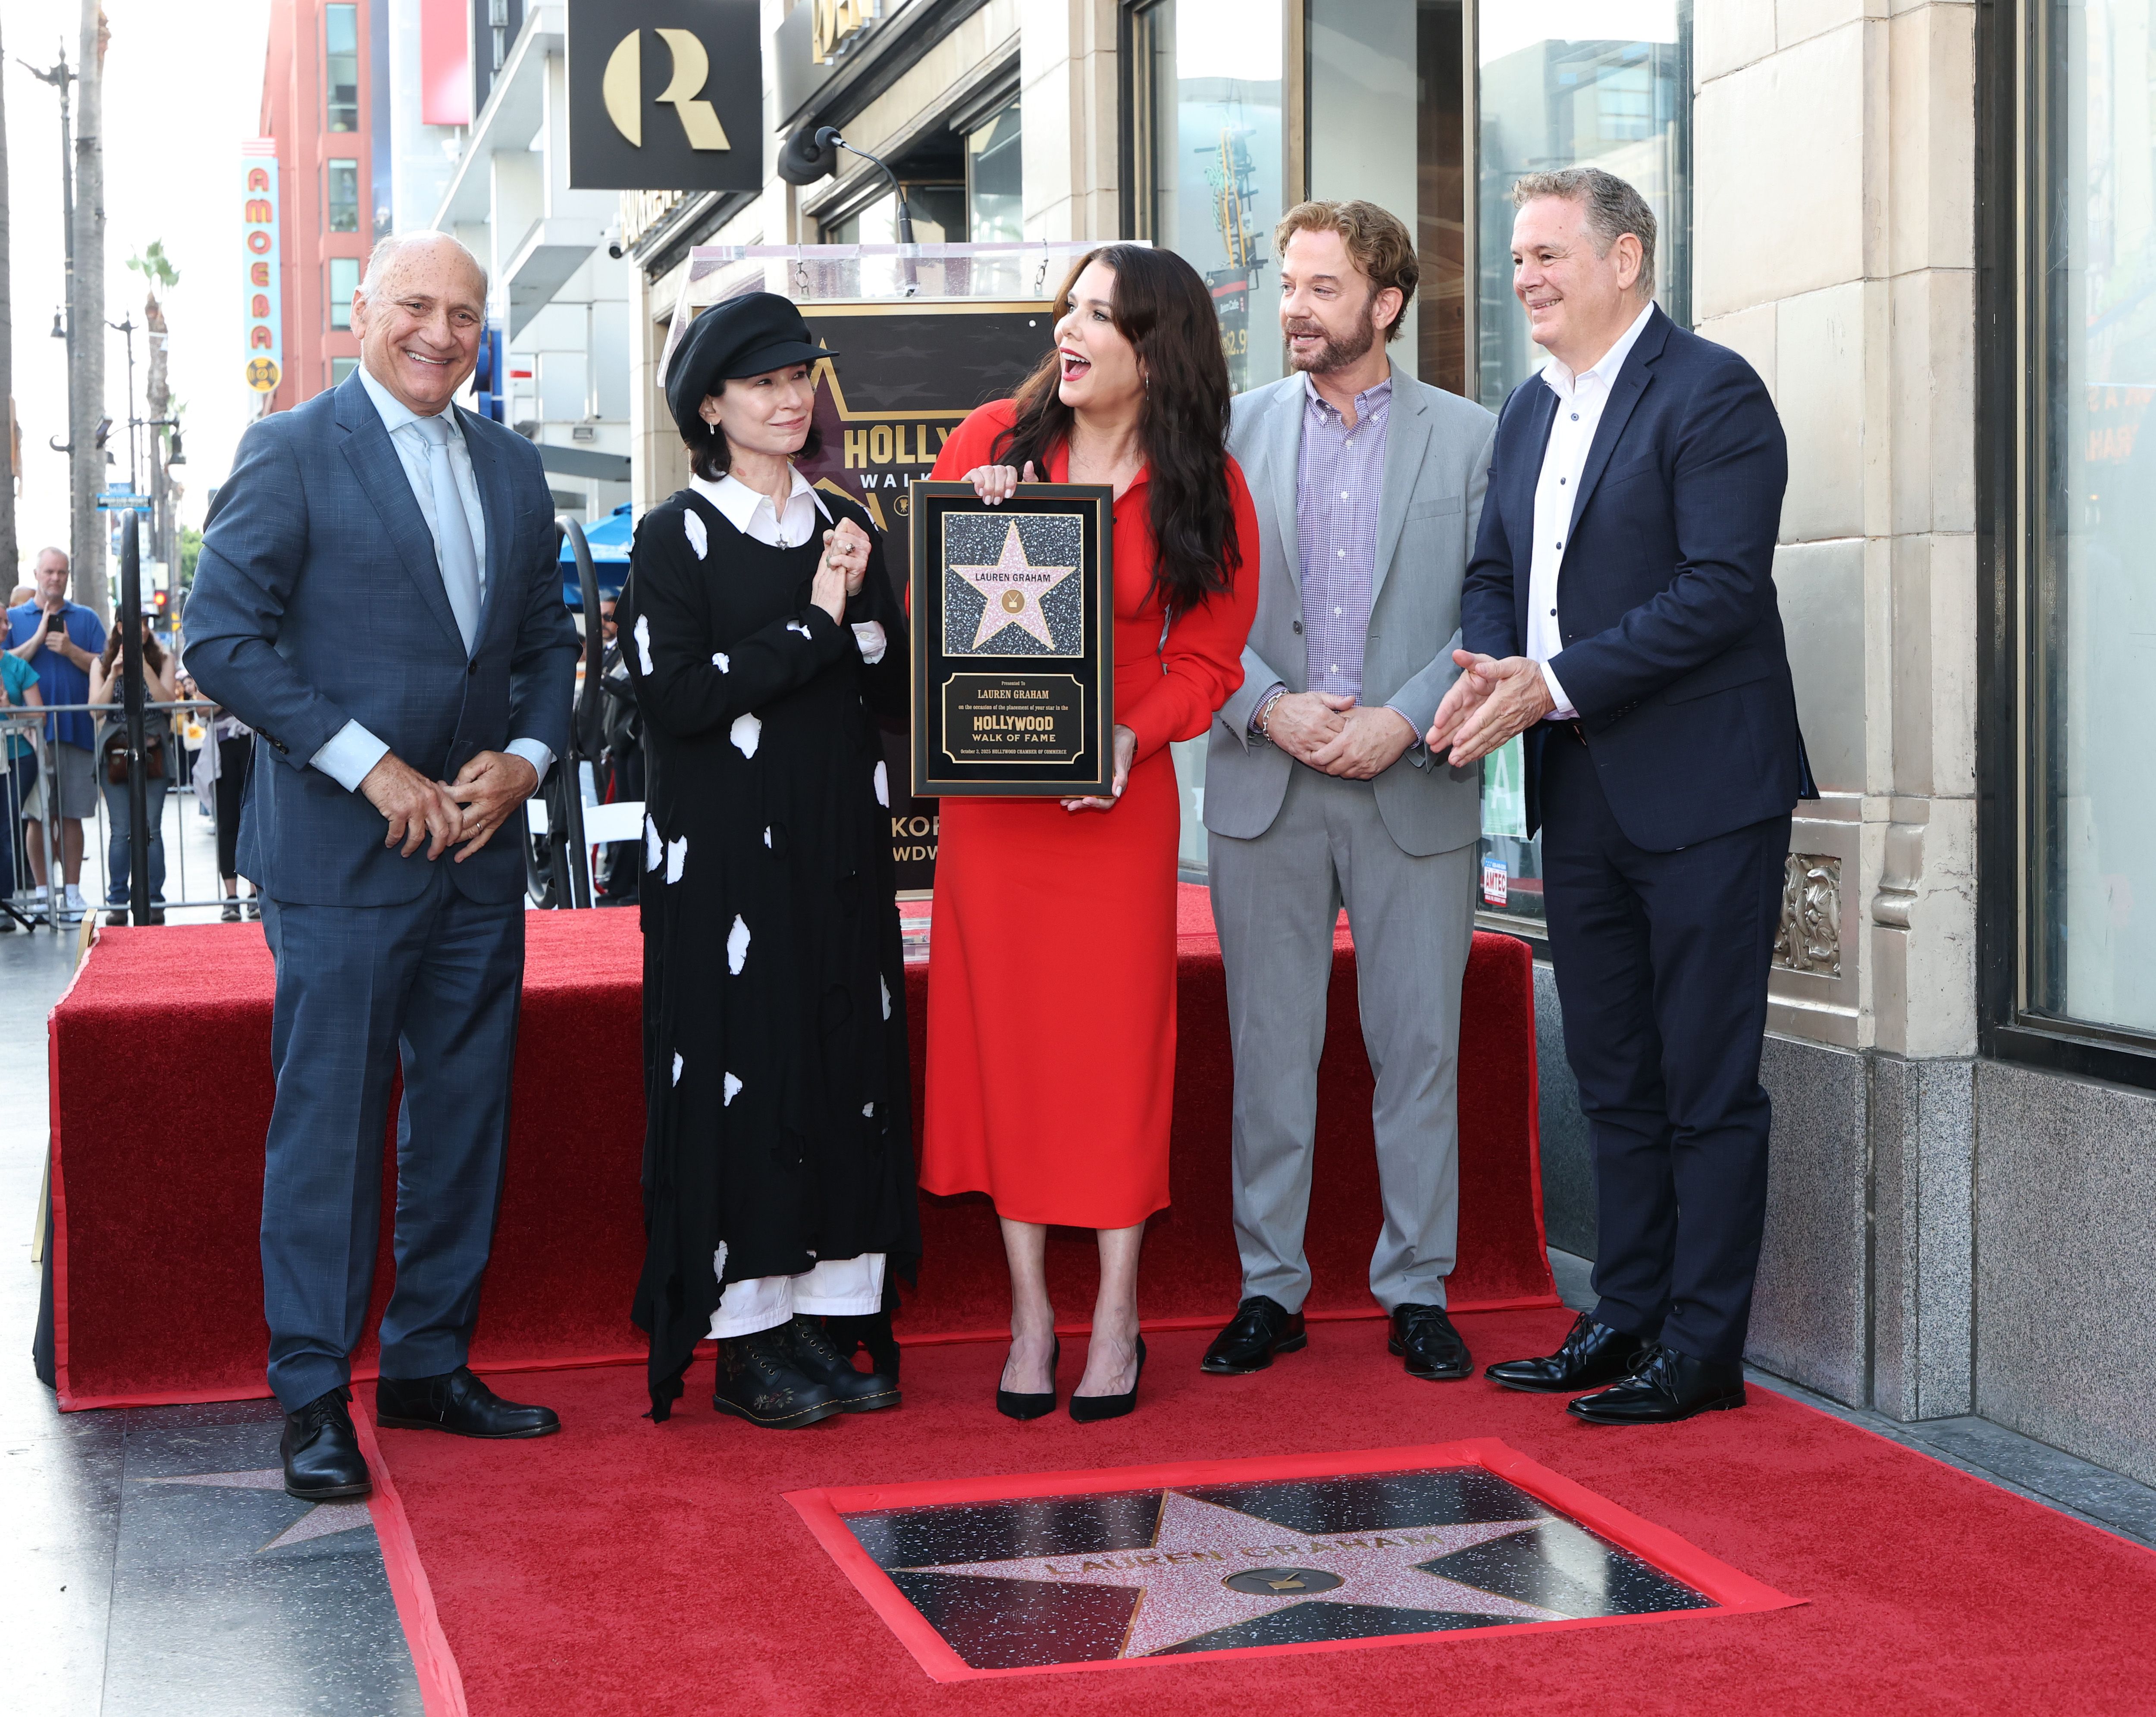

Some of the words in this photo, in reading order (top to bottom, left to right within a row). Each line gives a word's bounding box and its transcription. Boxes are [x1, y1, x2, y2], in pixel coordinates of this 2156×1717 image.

[245, 168, 273, 350] AMOEBA
[975, 573, 1009, 581] LAUREN
[1013, 574, 1050, 582] GRAHAM
[978, 689, 1011, 699] LAUREN
[1014, 690, 1049, 699] GRAHAM
[974, 715, 1053, 731] HOLLYWOOD
[1491, 749, 1512, 810] A
[1486, 871, 1505, 892] AMTEC
[1044, 1550, 1225, 1575] LAUREN
[1243, 1533, 1446, 1557] GRAHAM
